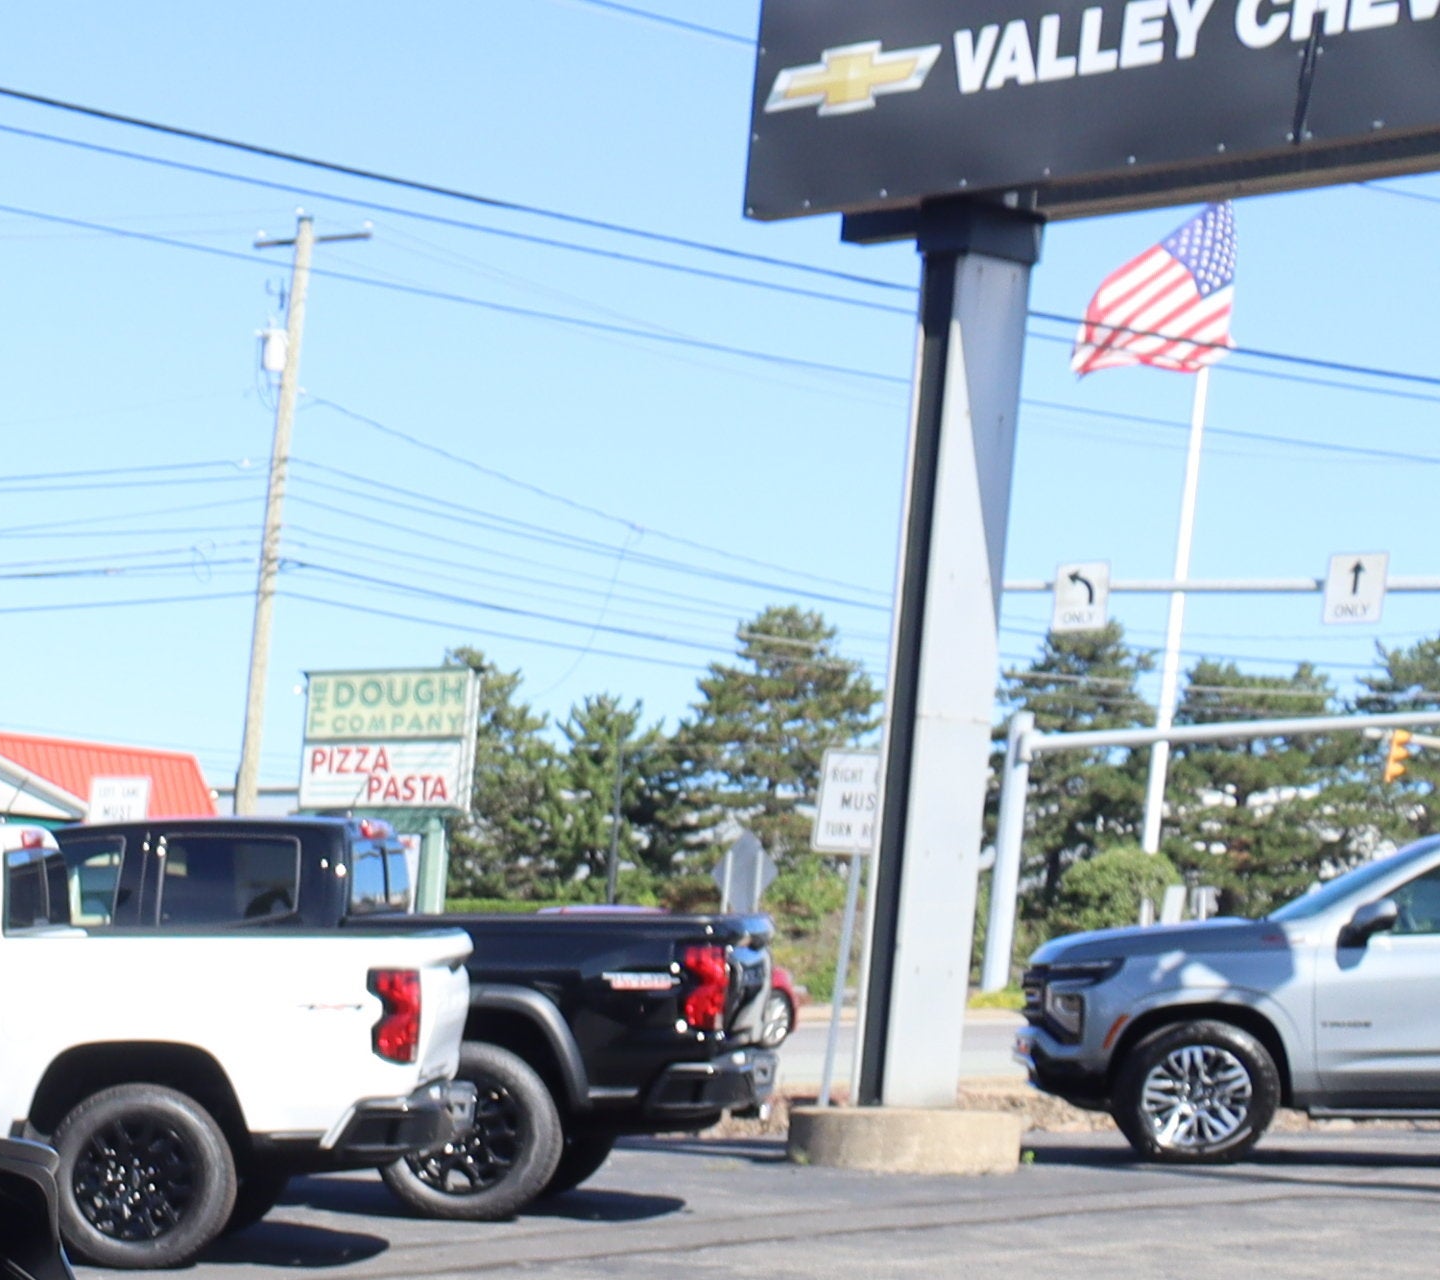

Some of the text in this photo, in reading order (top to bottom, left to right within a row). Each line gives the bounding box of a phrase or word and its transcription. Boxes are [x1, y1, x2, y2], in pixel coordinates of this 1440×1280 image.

[954, 0, 1207, 93] VALLEY
[1063, 610, 1095, 624] ONLY
[1334, 602, 1370, 618] ONLY
[333, 676, 465, 709] DOUGH
[331, 712, 464, 733] COMPANY
[311, 746, 388, 773] PIZZA
[367, 775, 447, 801] PASTA
